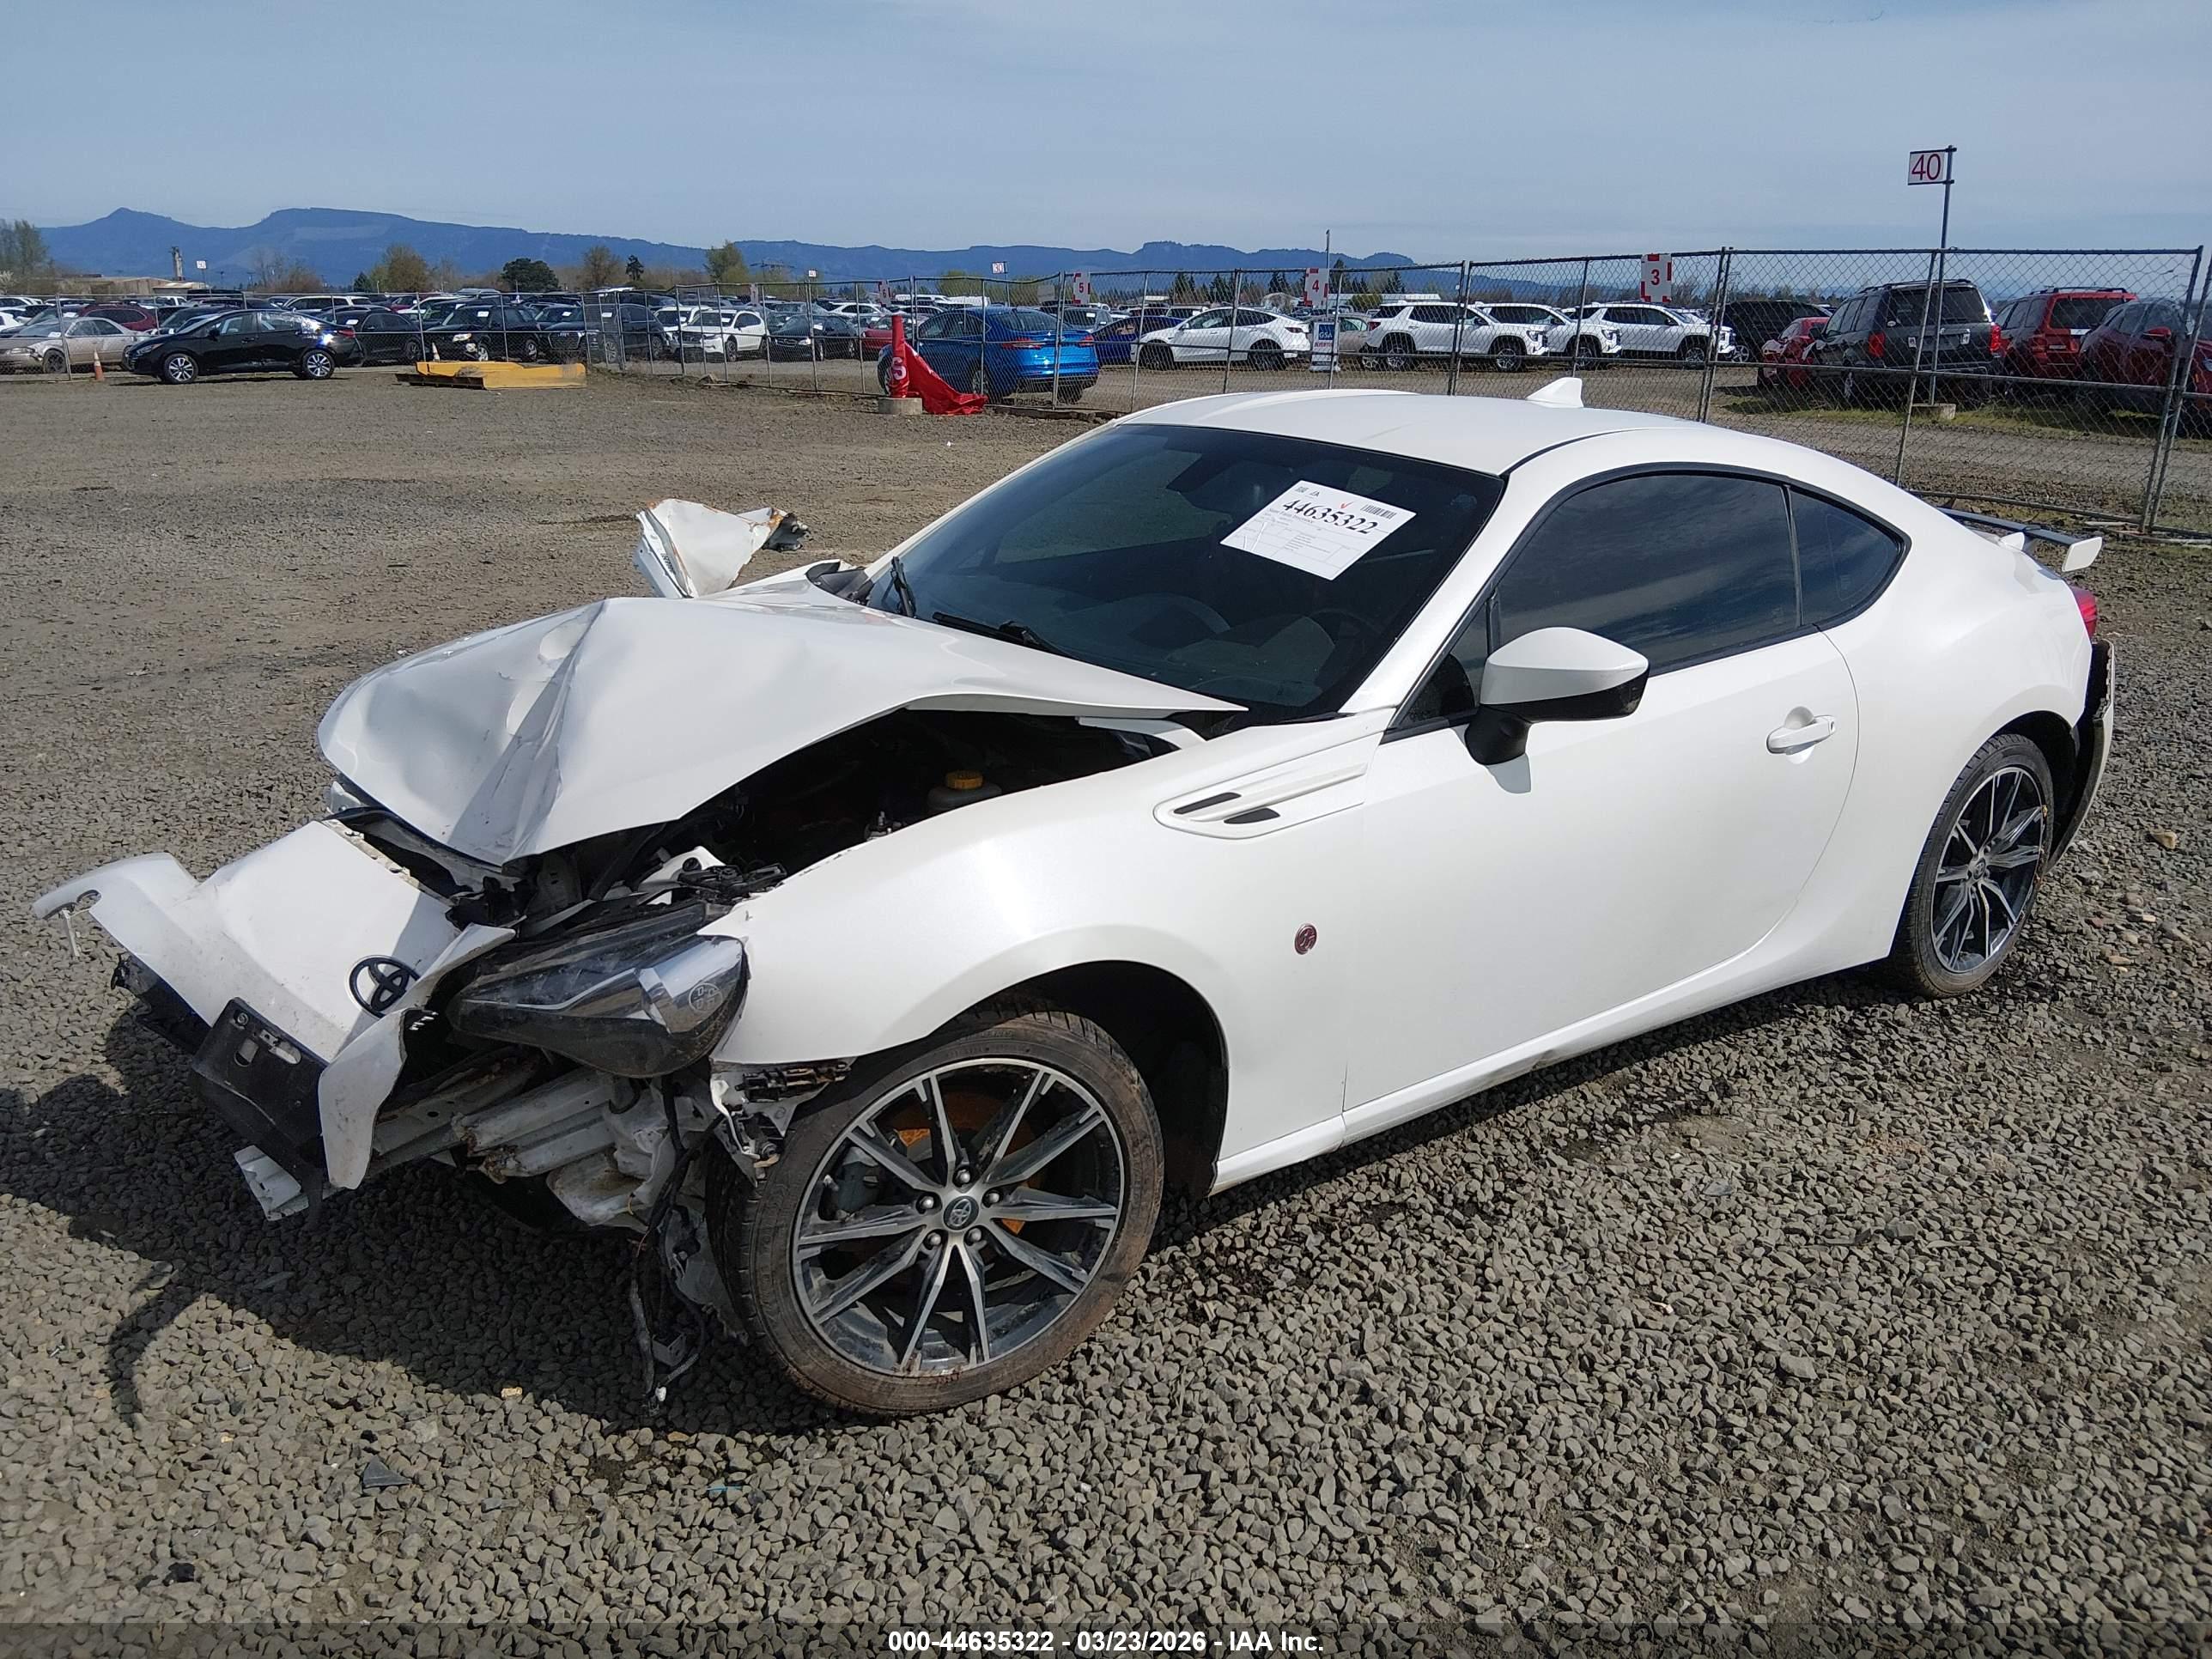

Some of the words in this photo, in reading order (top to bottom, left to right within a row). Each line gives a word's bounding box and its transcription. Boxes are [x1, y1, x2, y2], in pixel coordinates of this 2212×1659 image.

[1911, 153, 1941, 180] 40
[1650, 269, 1660, 285] 3
[1079, 283, 1085, 293] 5
[1312, 279, 1320, 293] 4
[1282, 499, 1378, 534] 44635322
